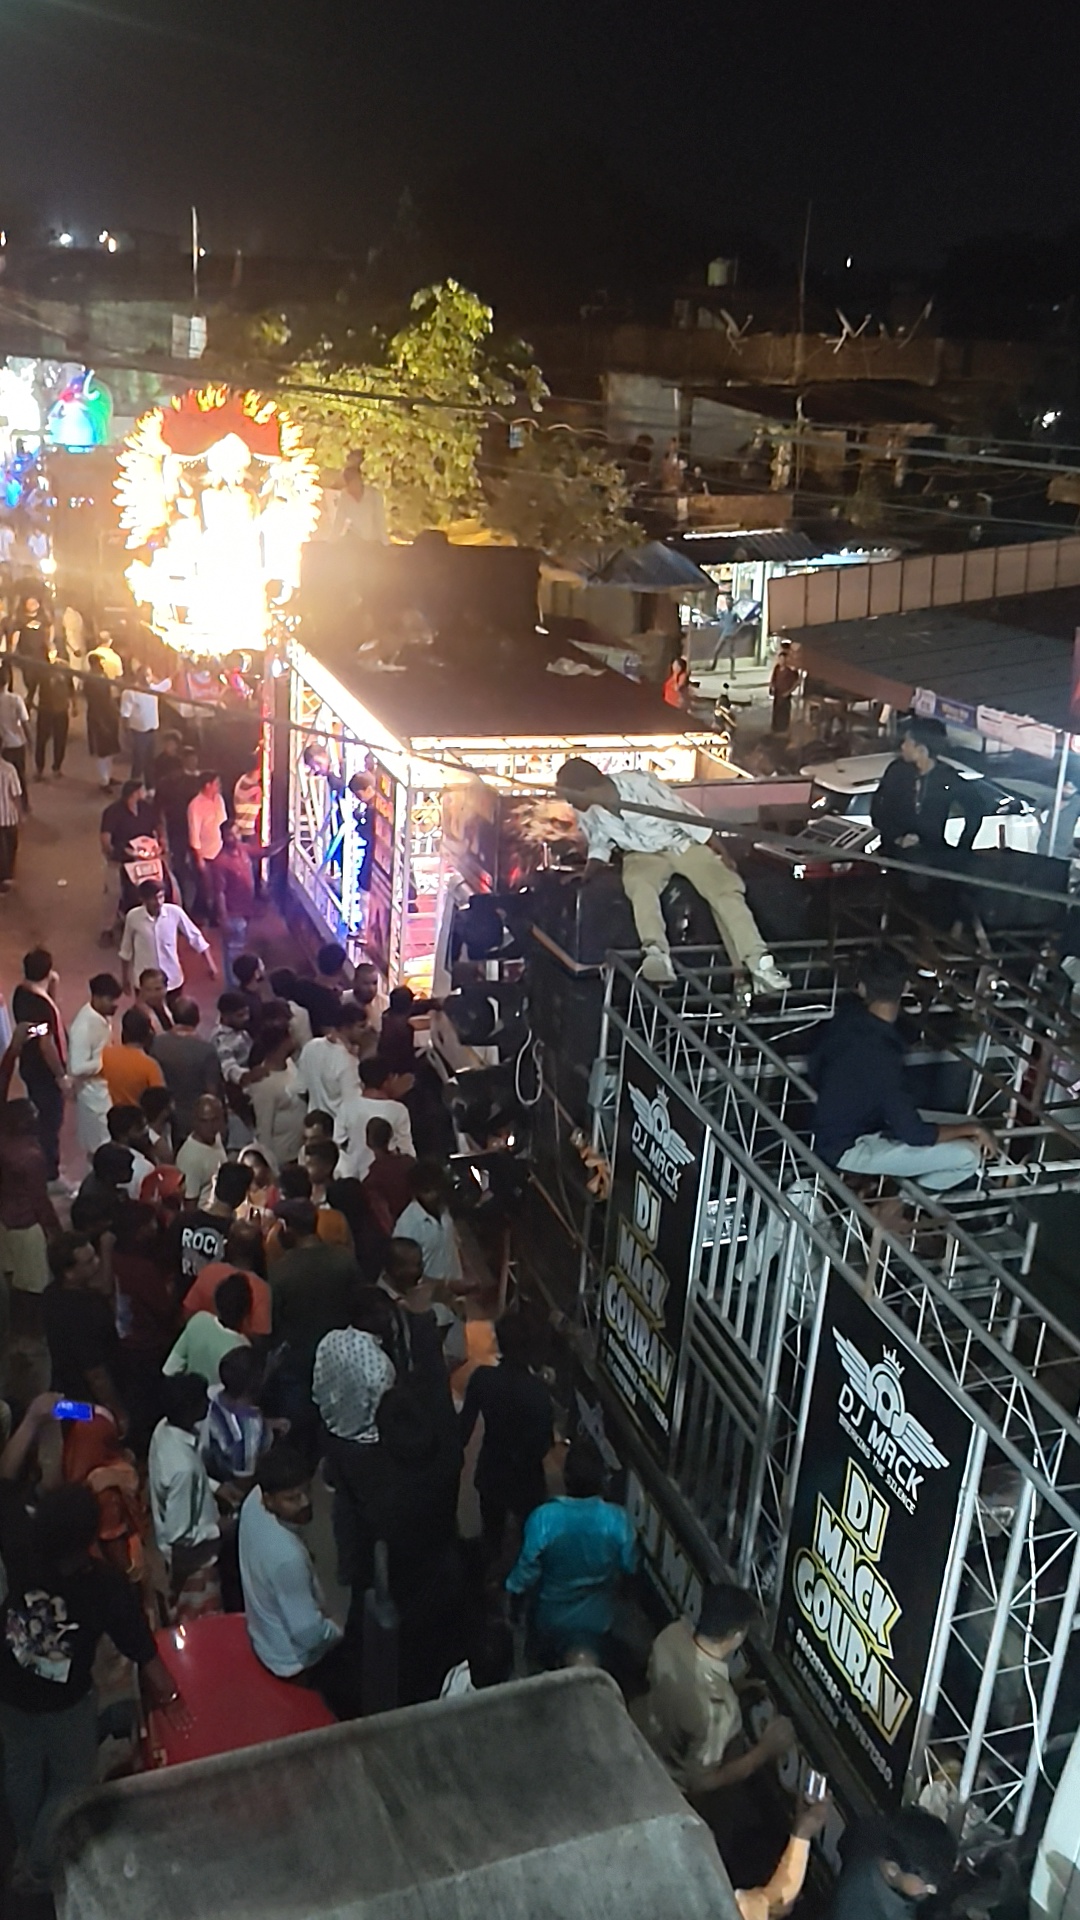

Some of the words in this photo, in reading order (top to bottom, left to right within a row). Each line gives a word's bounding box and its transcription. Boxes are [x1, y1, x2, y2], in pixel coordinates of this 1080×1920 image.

[632, 1121, 648, 1150] DJ
[649, 1141, 682, 1191] MACK
[635, 1175, 660, 1248] DJ
[618, 1218, 669, 1325] MACK
[604, 1268, 675, 1400] GOURAV
[838, 1383, 866, 1427] DJ
[867, 1420, 925, 1502] MACK
[884, 1472, 917, 1516] SILENCE
[844, 1462, 888, 1558] DJ
[815, 1497, 899, 1652] MACK
[795, 1551, 910, 1740] GOURAV
